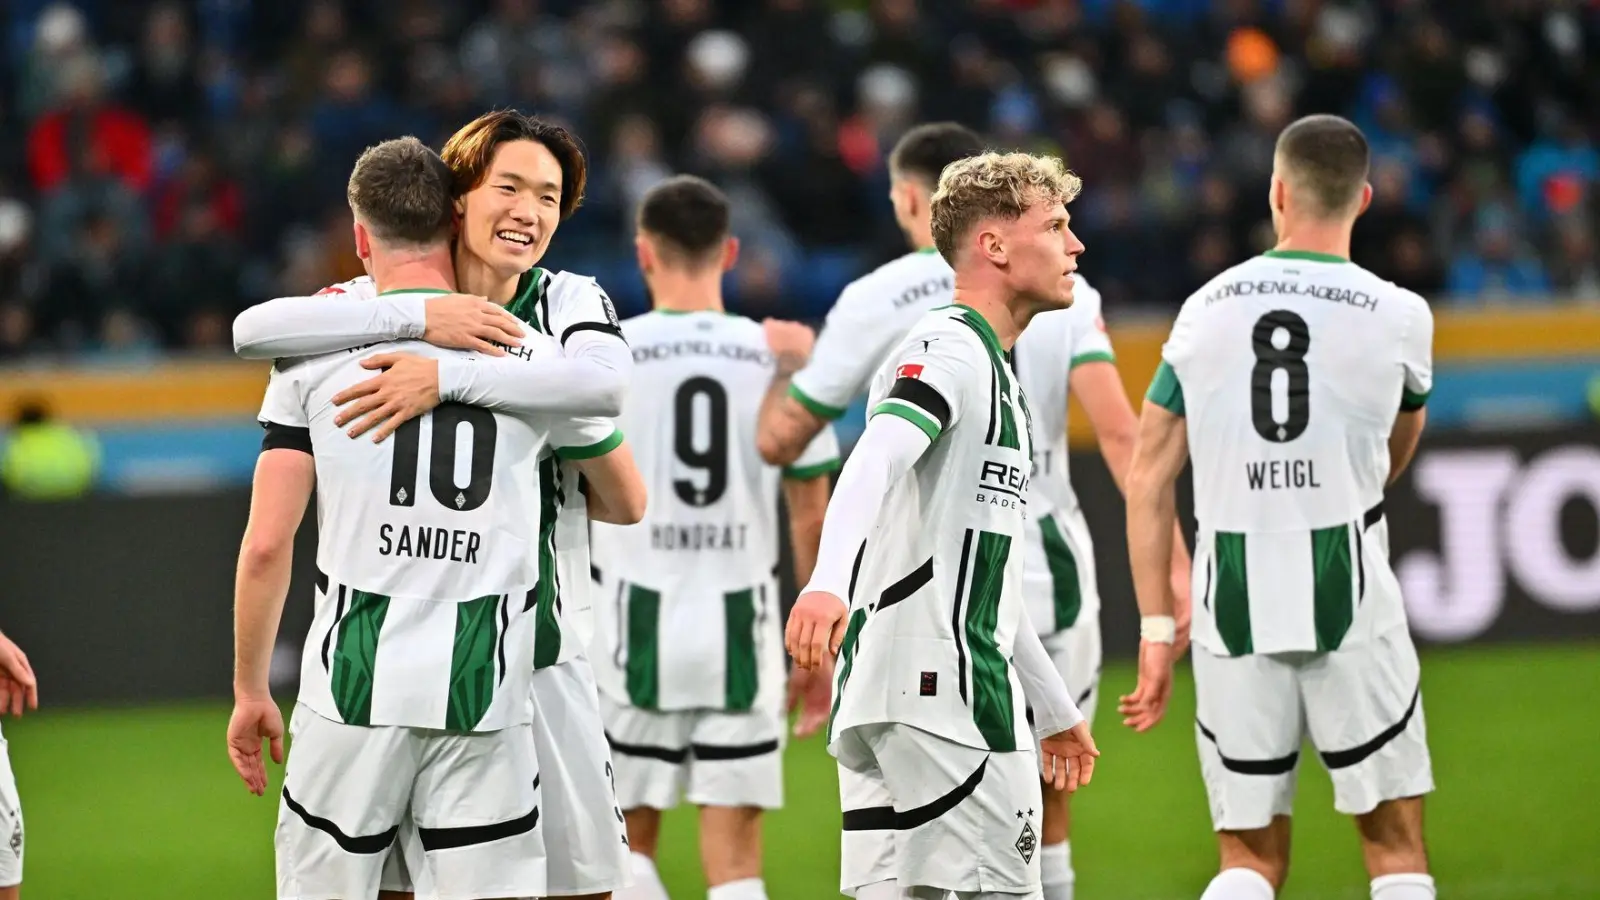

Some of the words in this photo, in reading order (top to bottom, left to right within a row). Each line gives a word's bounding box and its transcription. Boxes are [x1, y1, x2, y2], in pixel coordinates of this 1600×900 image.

[672, 375, 728, 508] 9
[1251, 309, 1310, 443] 8
[385, 380, 497, 511] 10
[1246, 459, 1321, 490] WEIGL
[379, 523, 481, 564] SANDER
